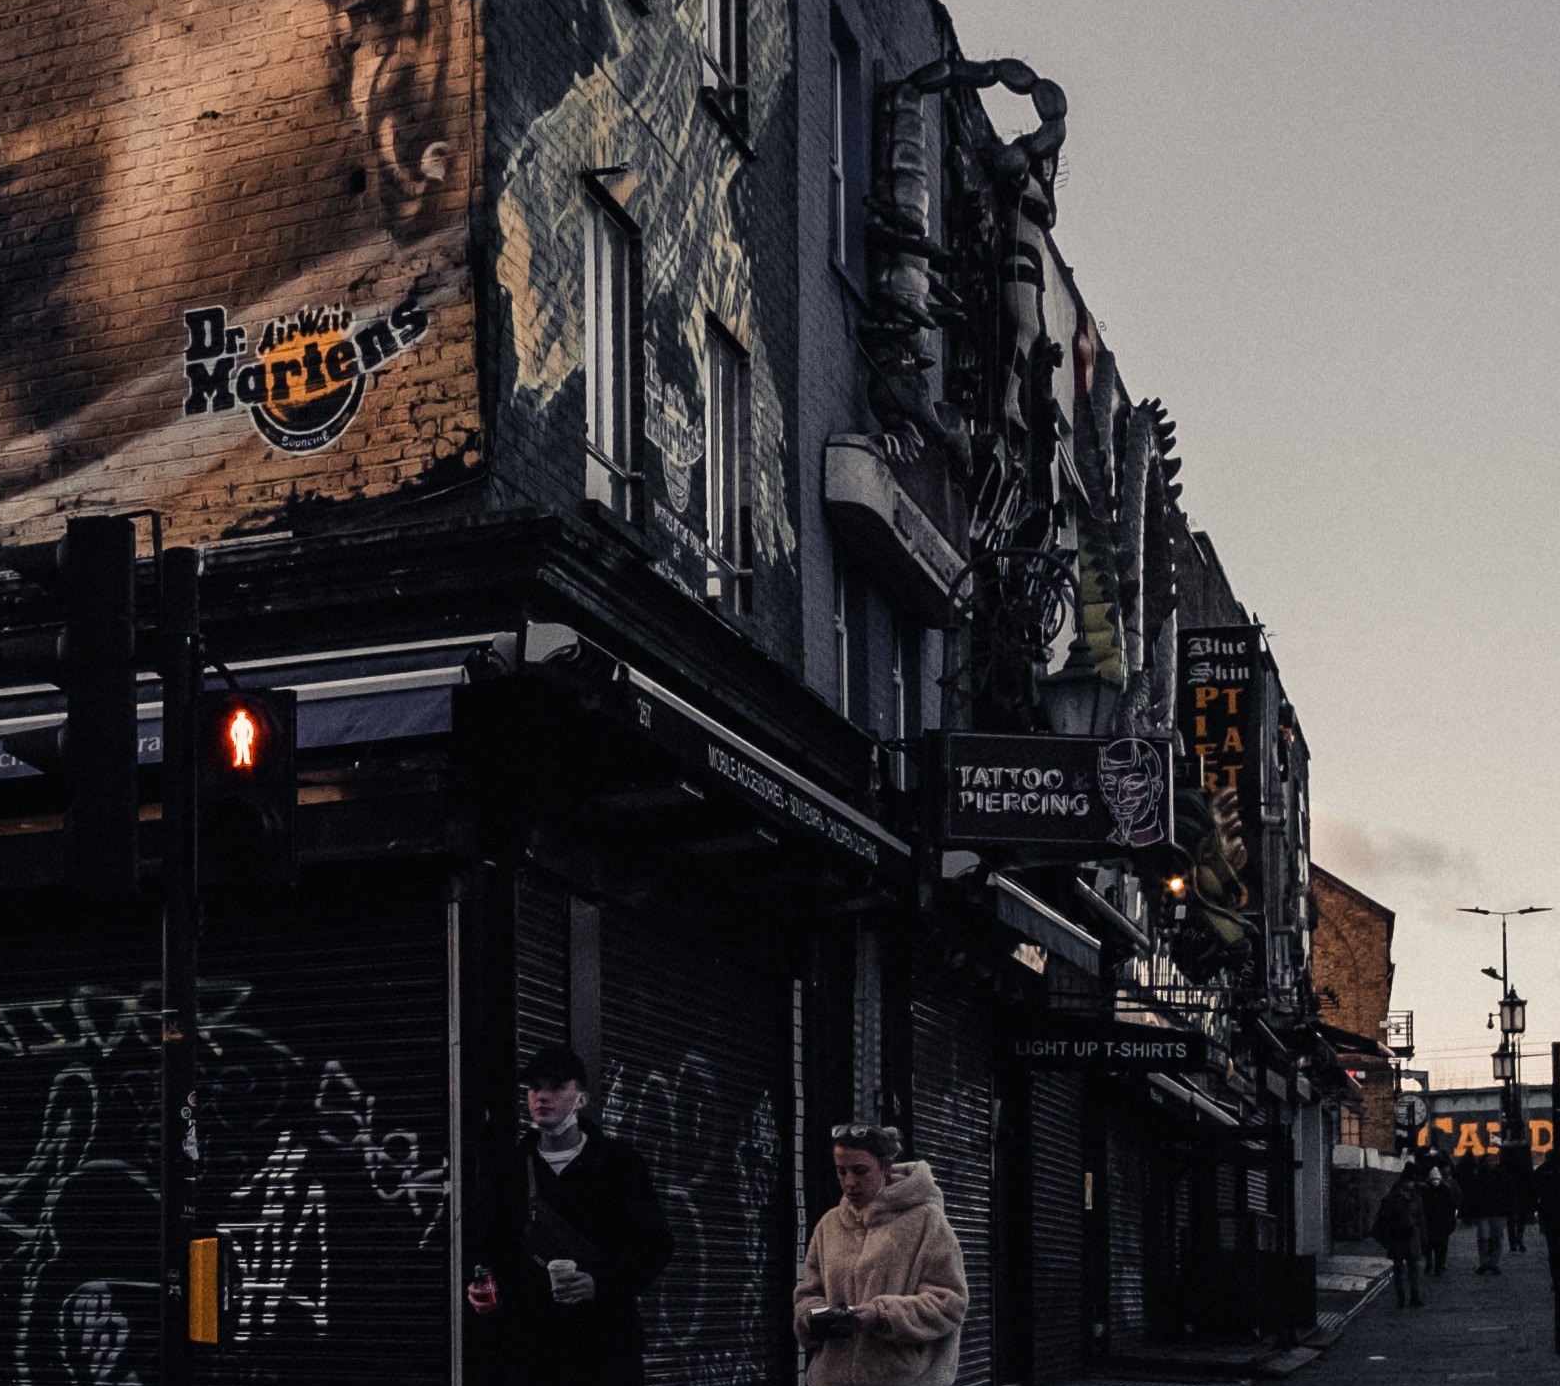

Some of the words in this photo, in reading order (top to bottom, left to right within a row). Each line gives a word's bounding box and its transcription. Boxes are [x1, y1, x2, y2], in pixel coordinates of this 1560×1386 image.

[184, 297, 429, 415] Martens
[1187, 637, 1247, 658] Blue
[708, 743, 737, 782] MOBILE
[956, 766, 1064, 789] TATTOO
[958, 791, 1090, 816] PIERCING
[1016, 1040, 1069, 1056] LIGHT
[1074, 1041, 1098, 1056] UP
[1104, 1042, 1188, 1059] T-SHIRTS
